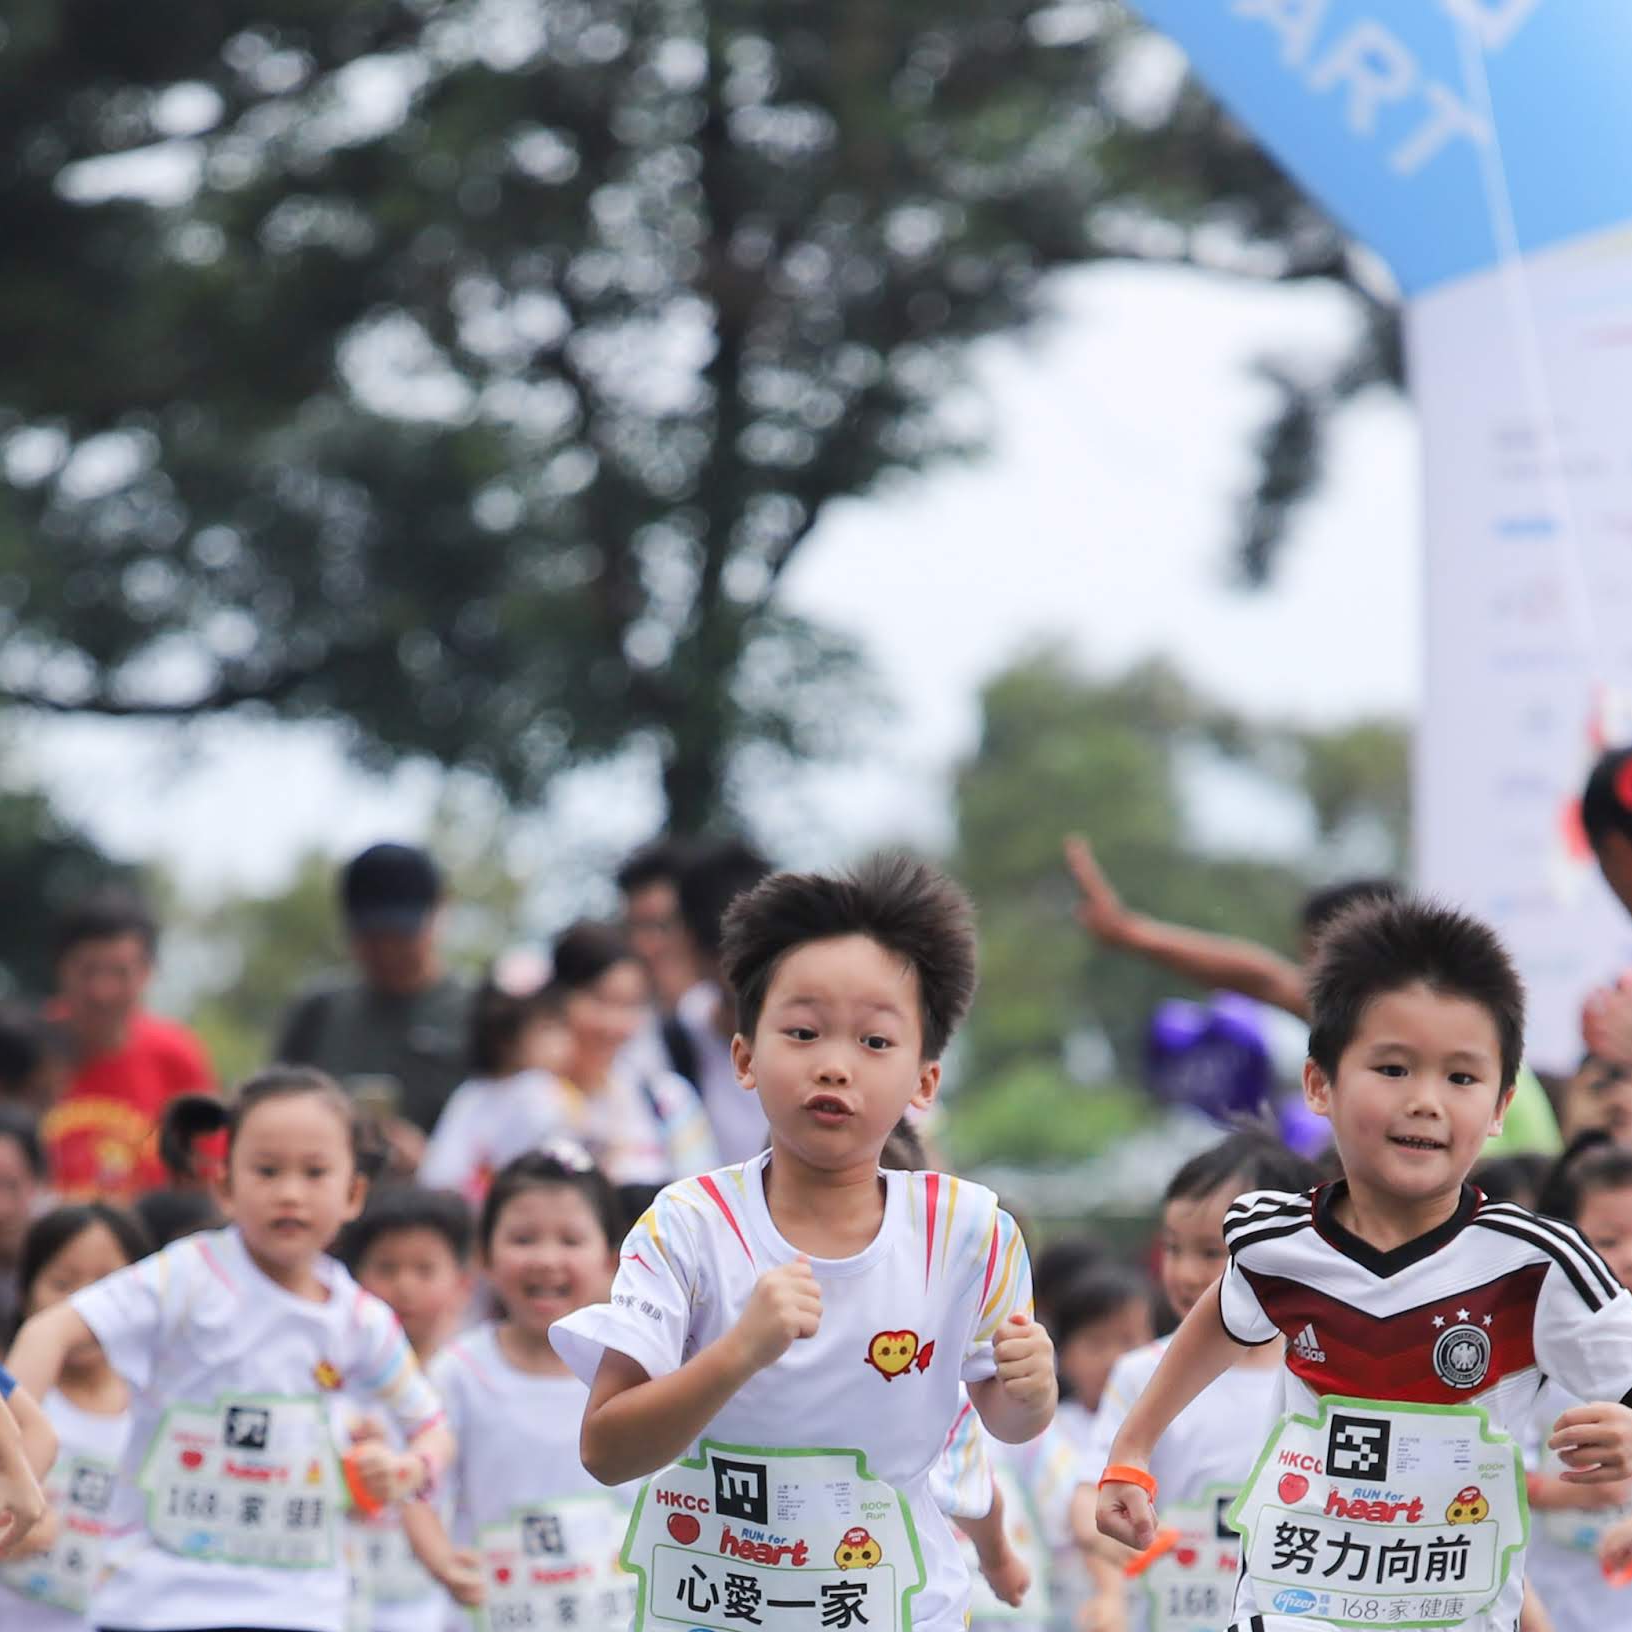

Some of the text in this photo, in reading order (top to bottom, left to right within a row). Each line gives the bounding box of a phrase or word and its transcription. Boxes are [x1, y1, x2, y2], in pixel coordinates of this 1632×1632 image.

[1279, 1450, 1324, 1475] HKCC
[656, 1489, 710, 1513] HKCC
[1324, 1488, 1424, 1523] heart
[1352, 1487, 1404, 1502] RUN for
[720, 1525, 808, 1566] heart
[741, 1527, 787, 1544] RUN for
[1271, 1521, 1471, 1585] 努力向前
[676, 1564, 870, 1629] 心愛一家
[1275, 1593, 1317, 1613] Pfizer
